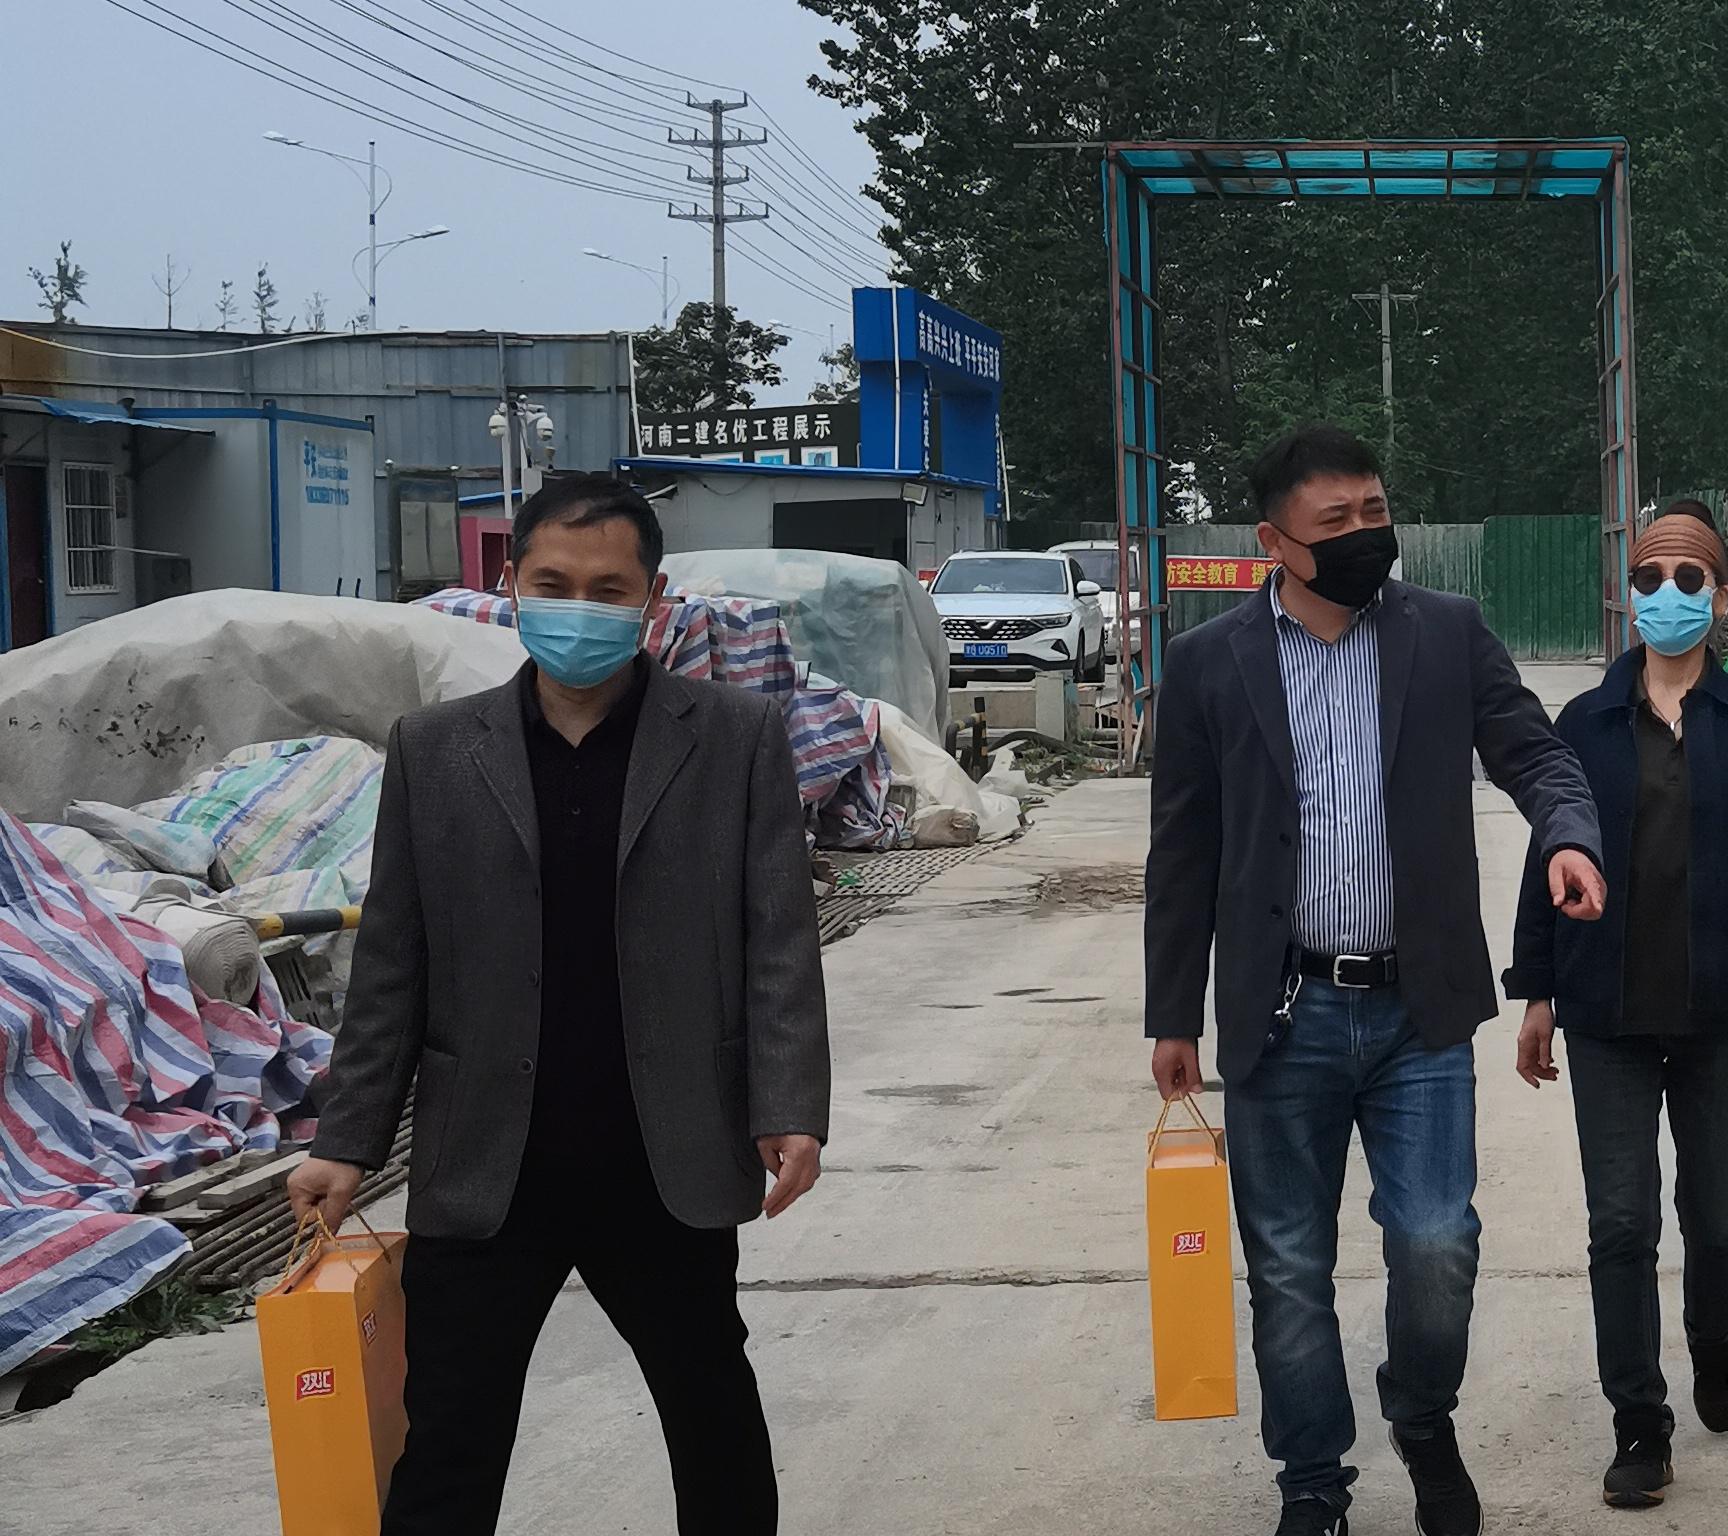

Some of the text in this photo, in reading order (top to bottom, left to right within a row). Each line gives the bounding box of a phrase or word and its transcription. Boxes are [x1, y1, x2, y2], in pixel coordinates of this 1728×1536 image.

[640, 413, 831, 449] 河南二建名优工程展示
